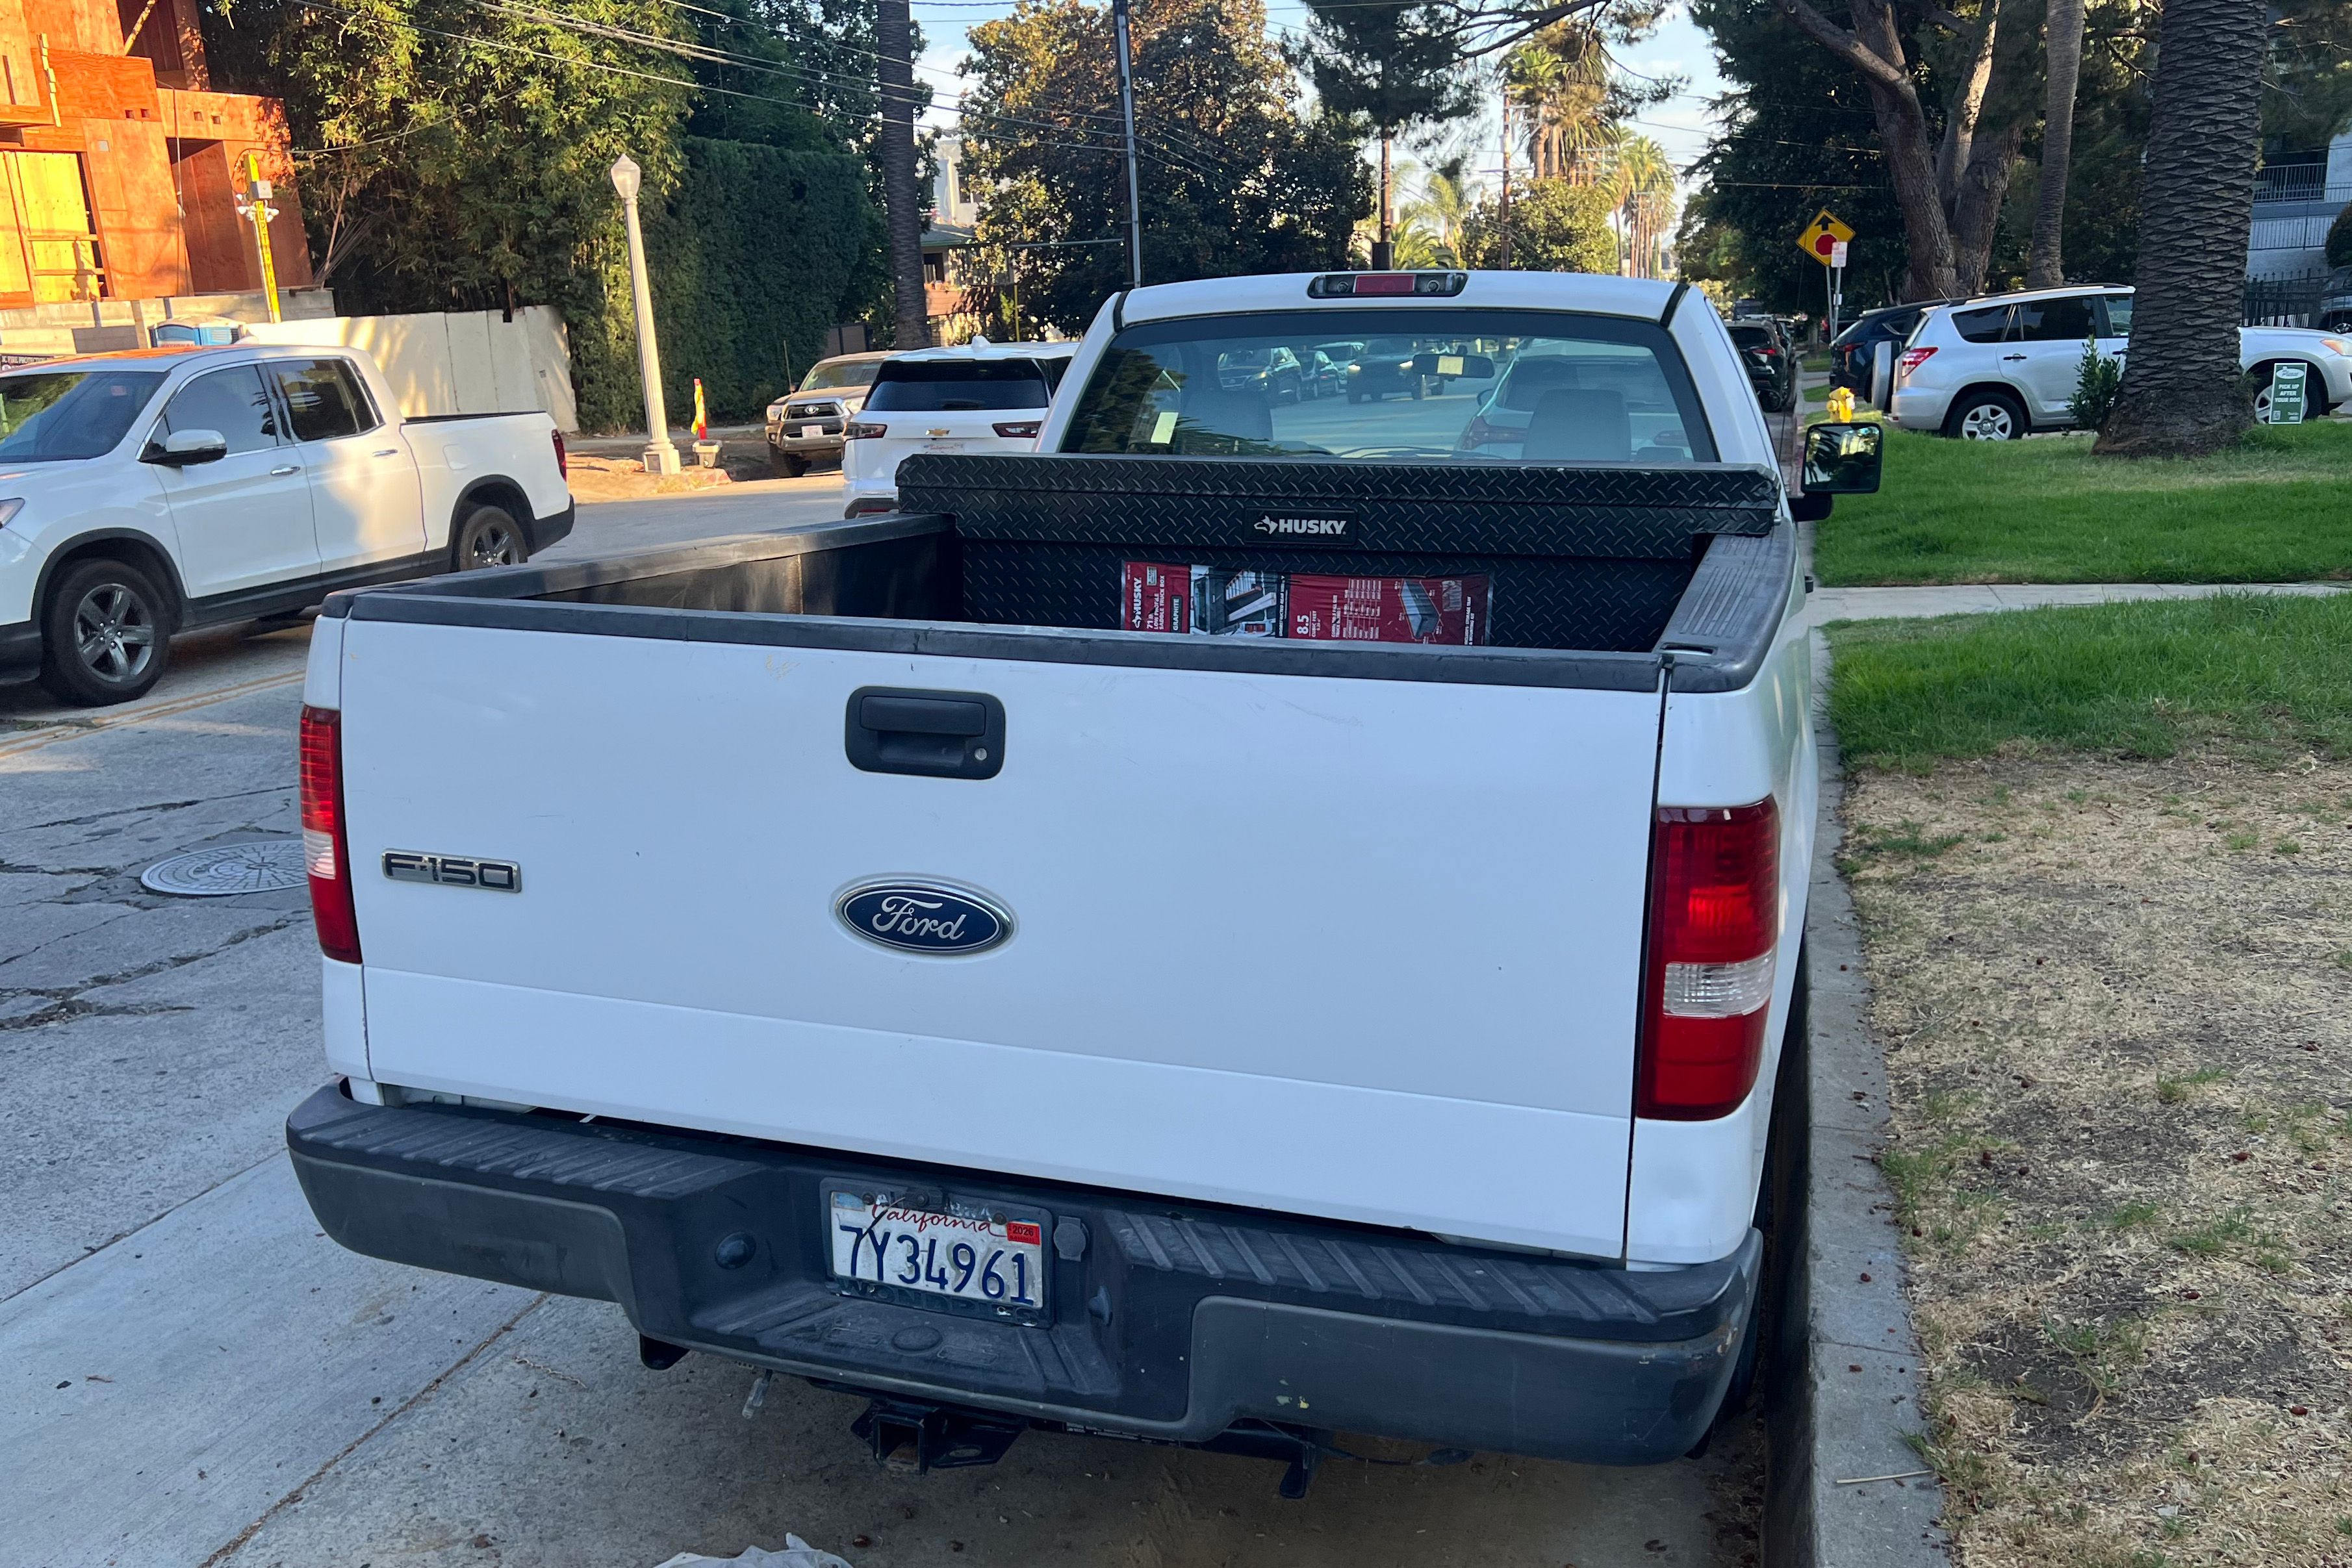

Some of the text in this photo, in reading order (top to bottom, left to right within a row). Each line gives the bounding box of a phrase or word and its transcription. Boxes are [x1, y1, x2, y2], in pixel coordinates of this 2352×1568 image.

[1279, 519, 1347, 535] HUSKY
[1147, 620, 1153, 629] 71
[1296, 614, 1309, 635] 8.5
[385, 853, 515, 889] F-150
[871, 895, 966, 941] Ford
[871, 1202, 1007, 1237] California
[1012, 1225, 1034, 1237] 2026
[839, 1225, 1034, 1306] 7Y34961
